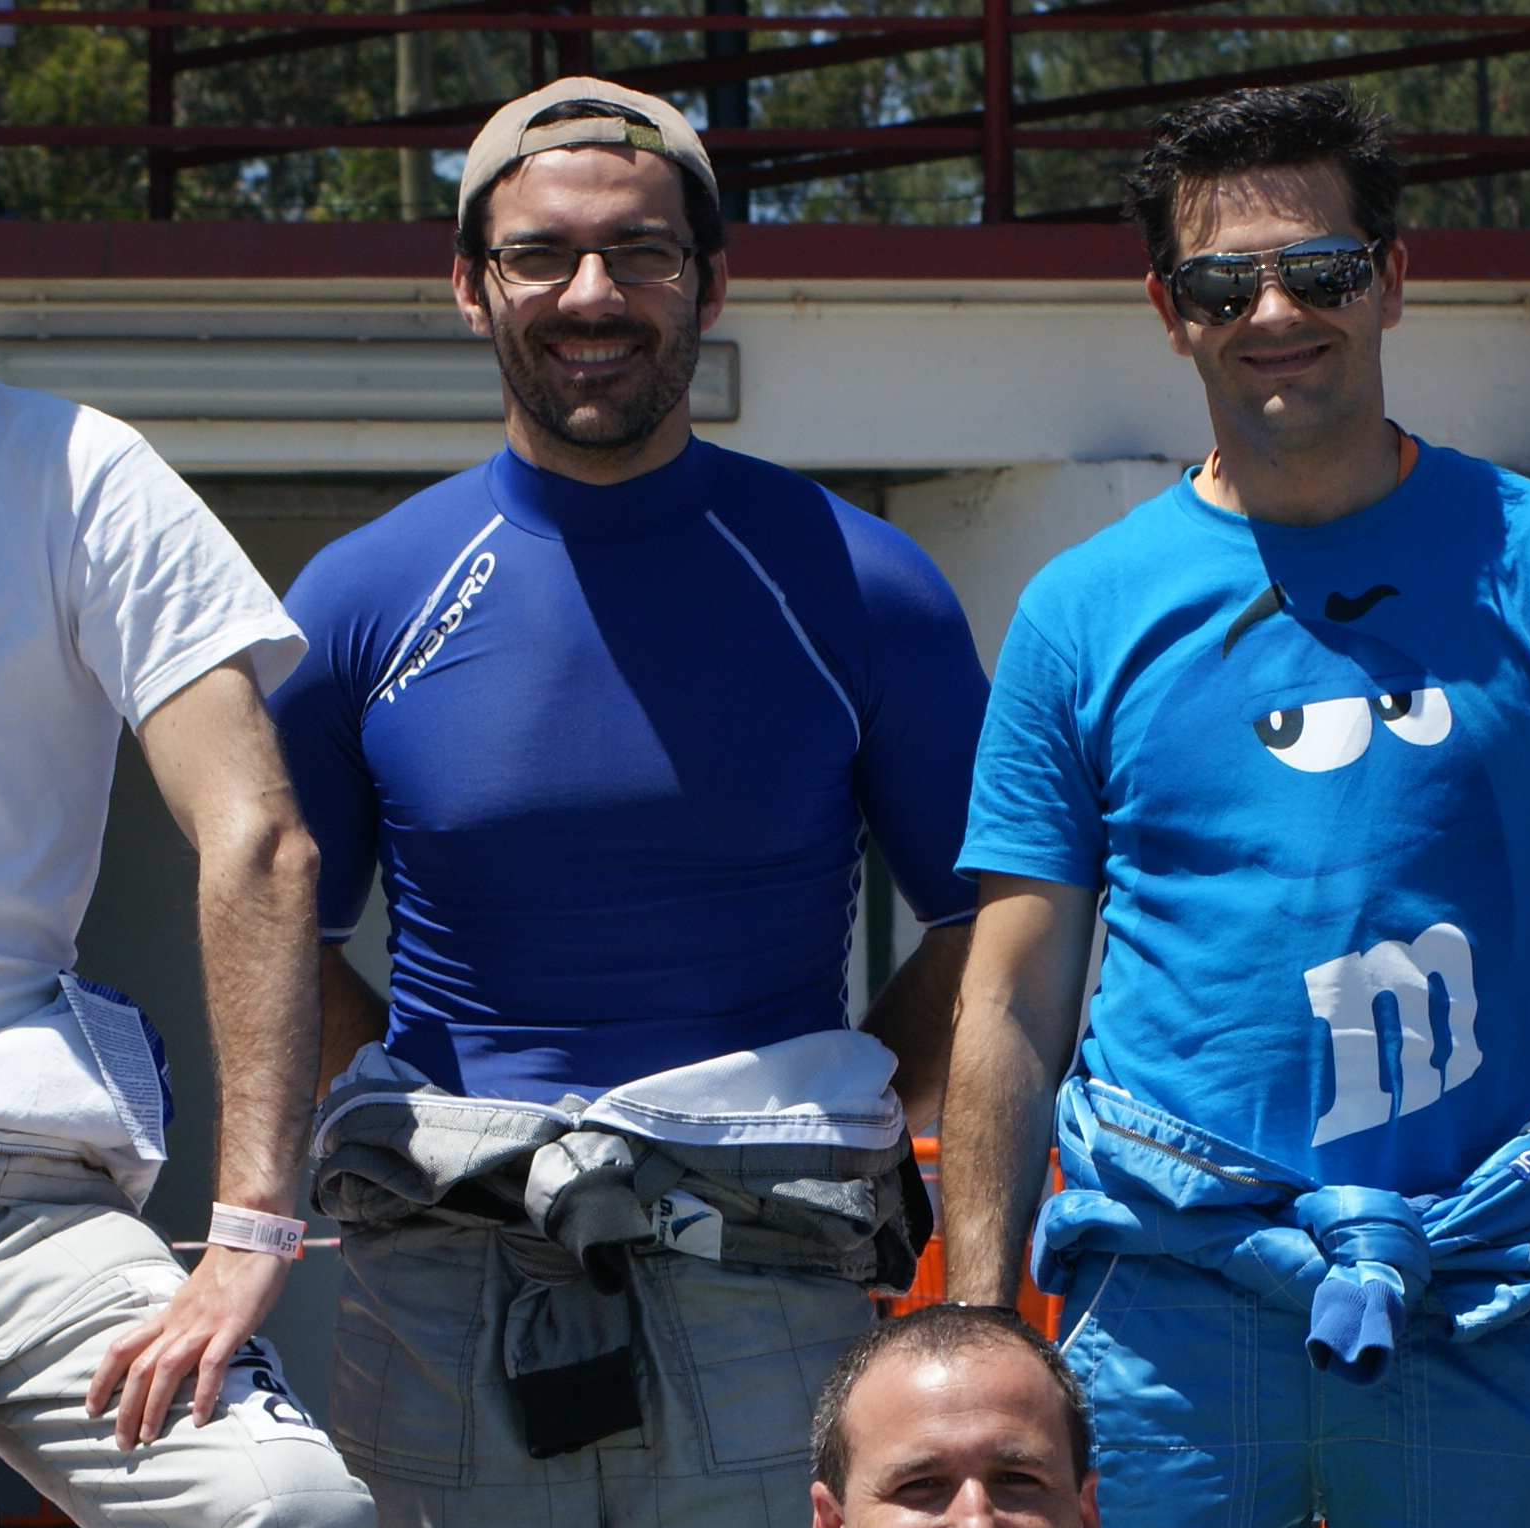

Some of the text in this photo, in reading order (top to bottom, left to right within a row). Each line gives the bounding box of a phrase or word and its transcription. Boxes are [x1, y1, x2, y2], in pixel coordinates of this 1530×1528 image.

[379, 552, 496, 703] TRIBORD
[1304, 922, 1483, 1148] m
[280, 1241, 296, 1253] 231
[287, 1231, 297, 1242] D
